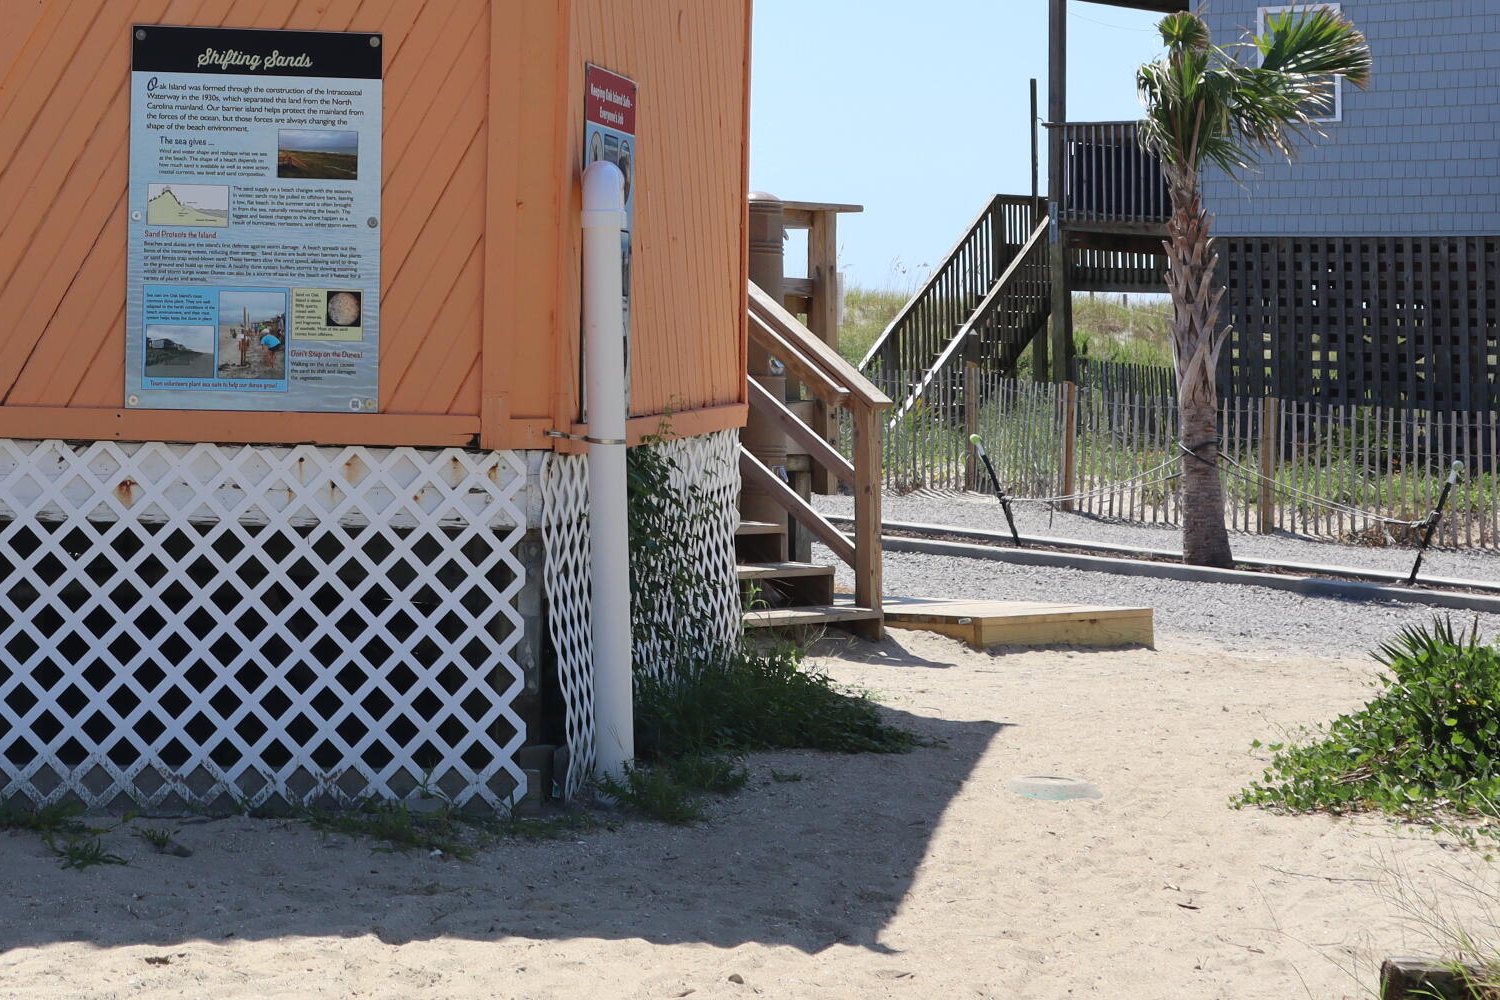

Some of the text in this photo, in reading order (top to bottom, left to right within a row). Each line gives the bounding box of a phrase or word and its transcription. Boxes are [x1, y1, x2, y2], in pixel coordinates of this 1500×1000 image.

[197, 47, 313, 71] Shifting Sands
[227, 85, 252, 94] through
[266, 86, 304, 94] construction
[147, 92, 179, 102] Waterway
[243, 95, 274, 105] separated
[264, 106, 280, 115] helps
[282, 107, 305, 116] protect
[147, 122, 165, 131] shape
[286, 117, 307, 126] always
[308, 117, 335, 126] changing
[160, 136, 172, 144] The
[189, 138, 206, 147] gives
